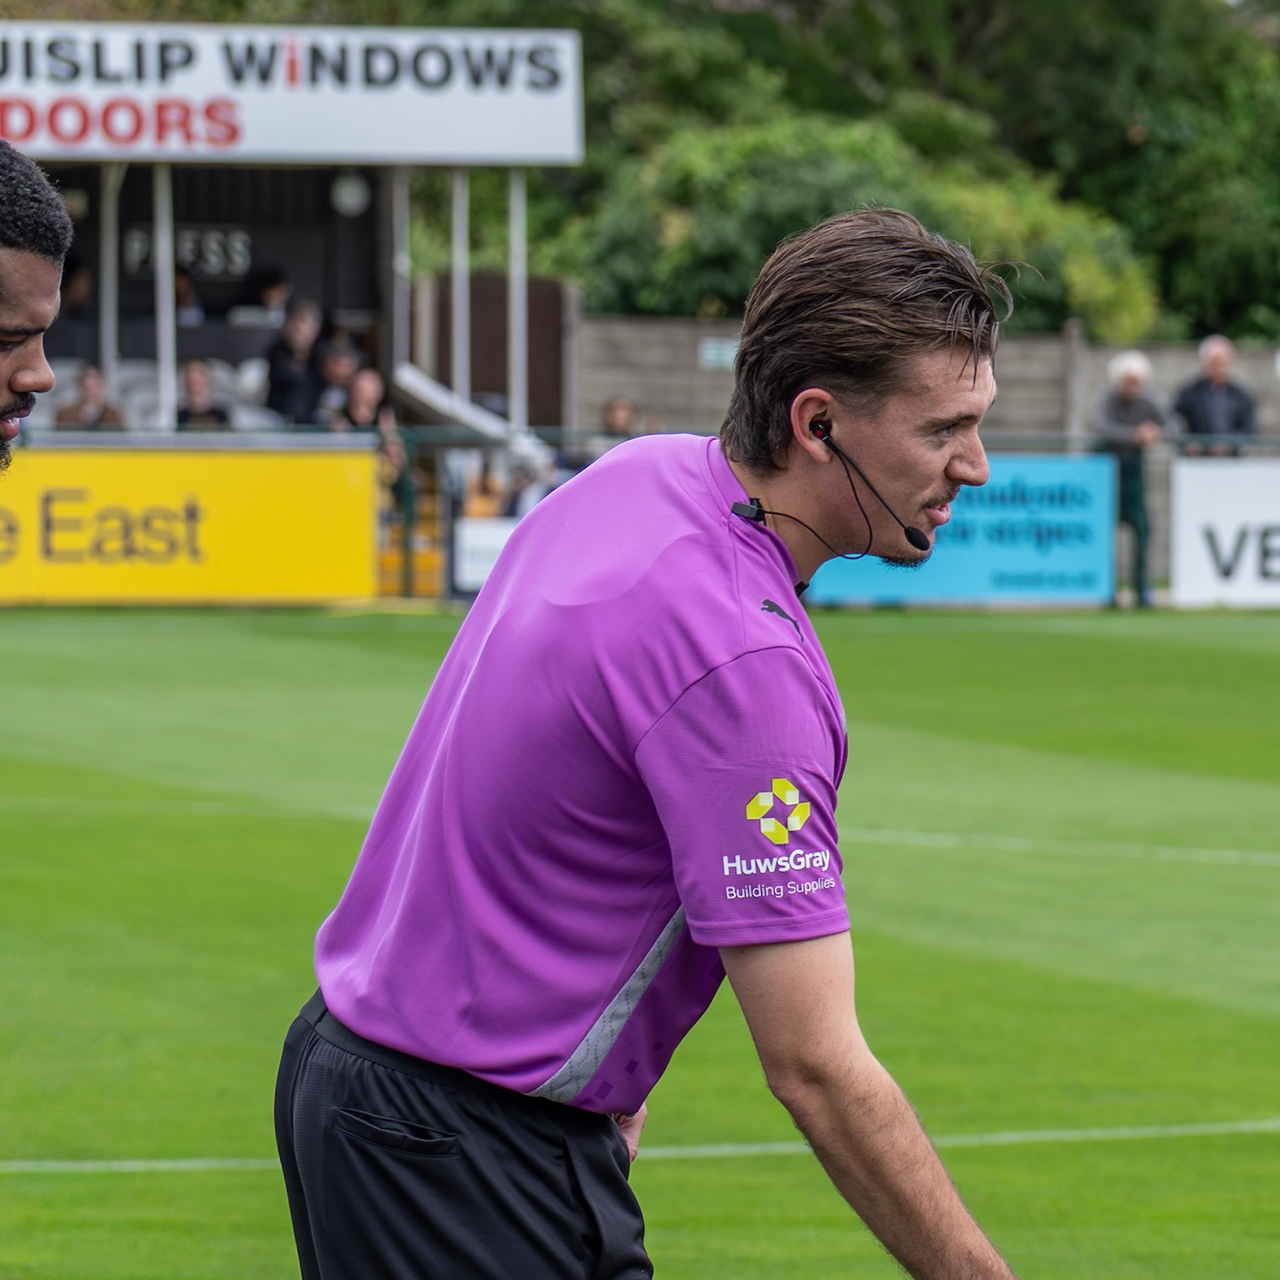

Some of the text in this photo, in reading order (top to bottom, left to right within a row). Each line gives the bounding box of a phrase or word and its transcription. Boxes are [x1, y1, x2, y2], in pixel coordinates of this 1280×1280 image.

[122, 229, 251, 275] PESS
[40, 486, 207, 564] East
[722, 848, 831, 877] HuwsGray
[725, 876, 836, 900] Building Supplies
